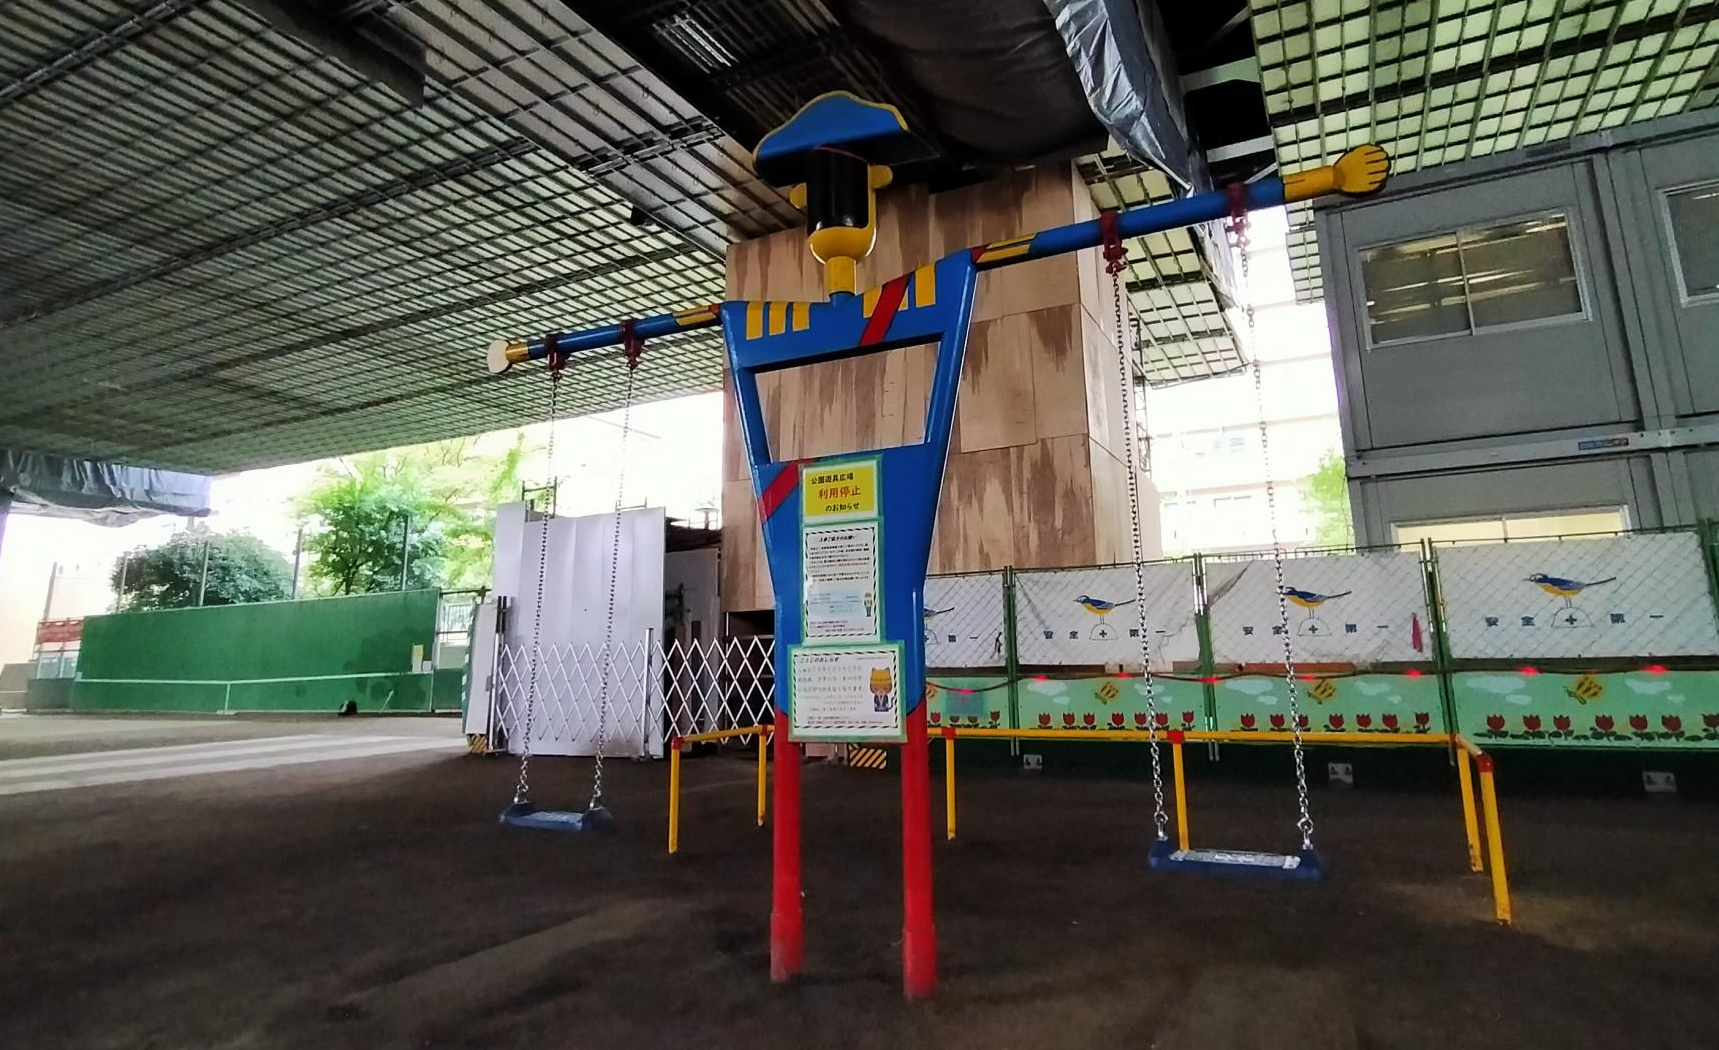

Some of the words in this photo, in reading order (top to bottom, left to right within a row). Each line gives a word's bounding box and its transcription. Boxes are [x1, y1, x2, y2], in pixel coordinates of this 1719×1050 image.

[811, 472, 854, 485] 公園遊具広場
[818, 485, 862, 500] 利用停止
[825, 502, 860, 512] のお知らせ
